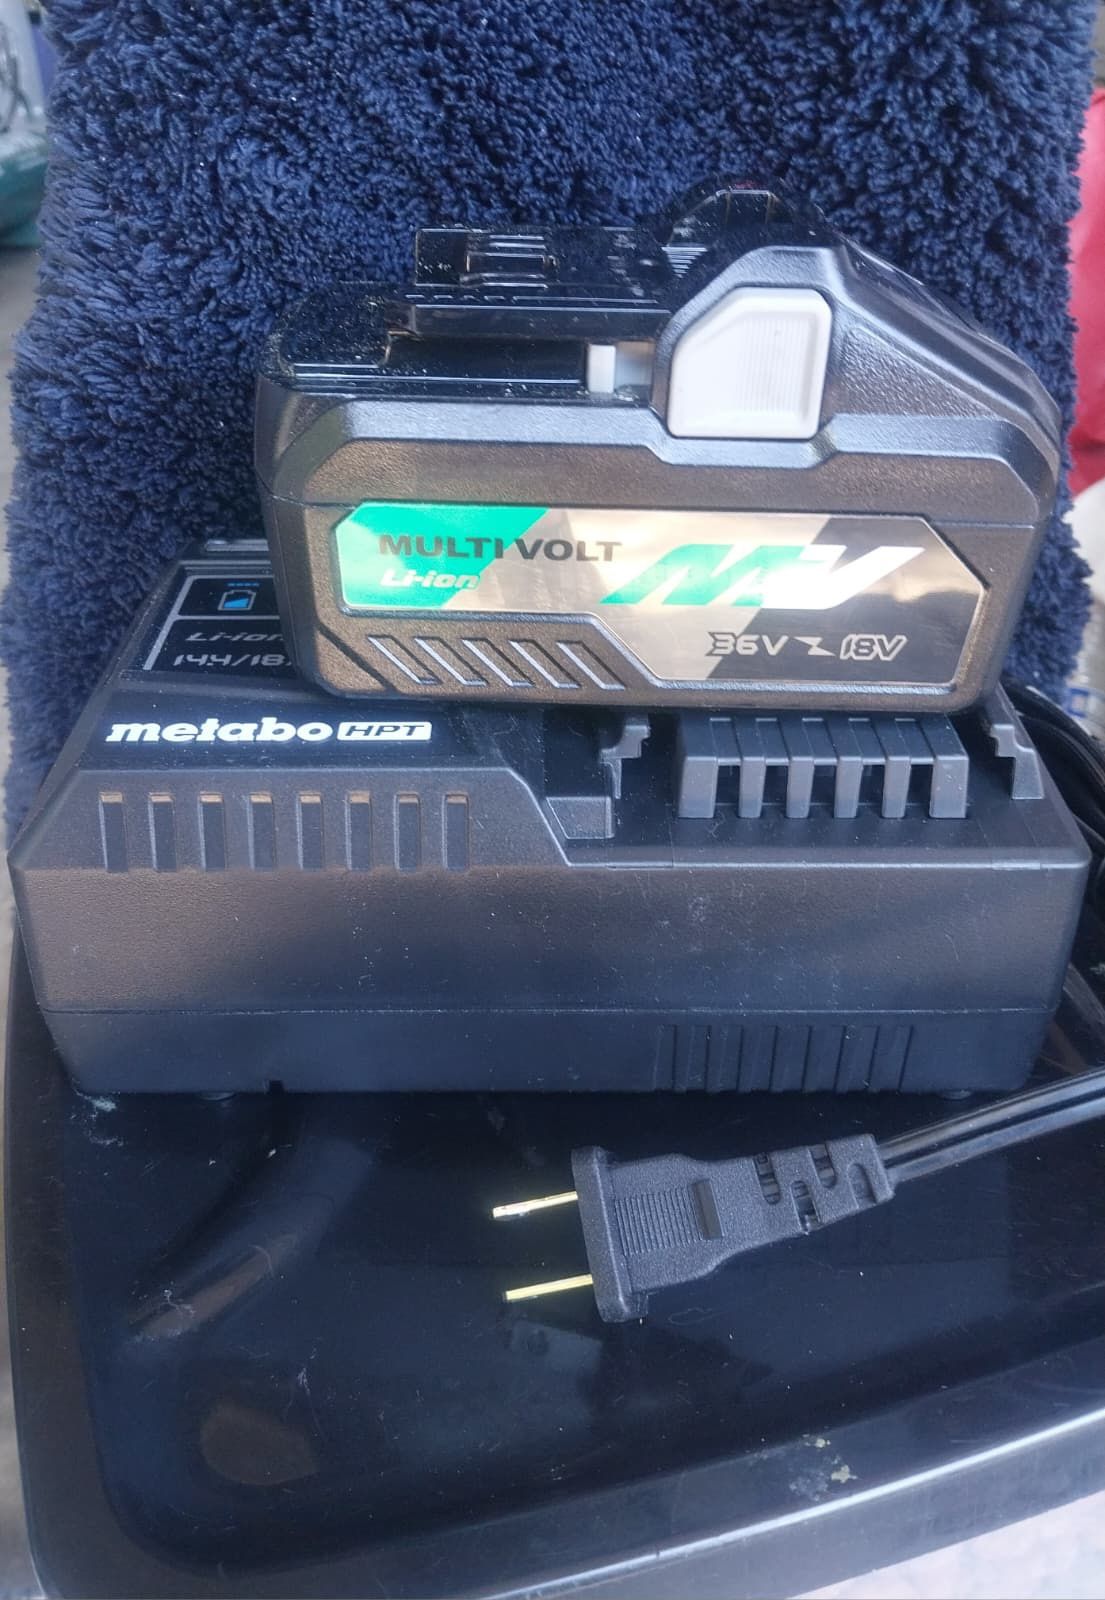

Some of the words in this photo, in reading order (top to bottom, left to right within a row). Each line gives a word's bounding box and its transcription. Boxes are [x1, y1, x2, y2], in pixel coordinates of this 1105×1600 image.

[378, 534, 505, 560] MULTI
[514, 539, 622, 562] VOLT
[379, 568, 481, 590] Li-ion
[705, 632, 789, 657] 36V
[839, 633, 908, 661] 18V
[173, 654, 292, 666] 14.4/18
[105, 716, 333, 742] metabo
[343, 723, 429, 739] HPT
